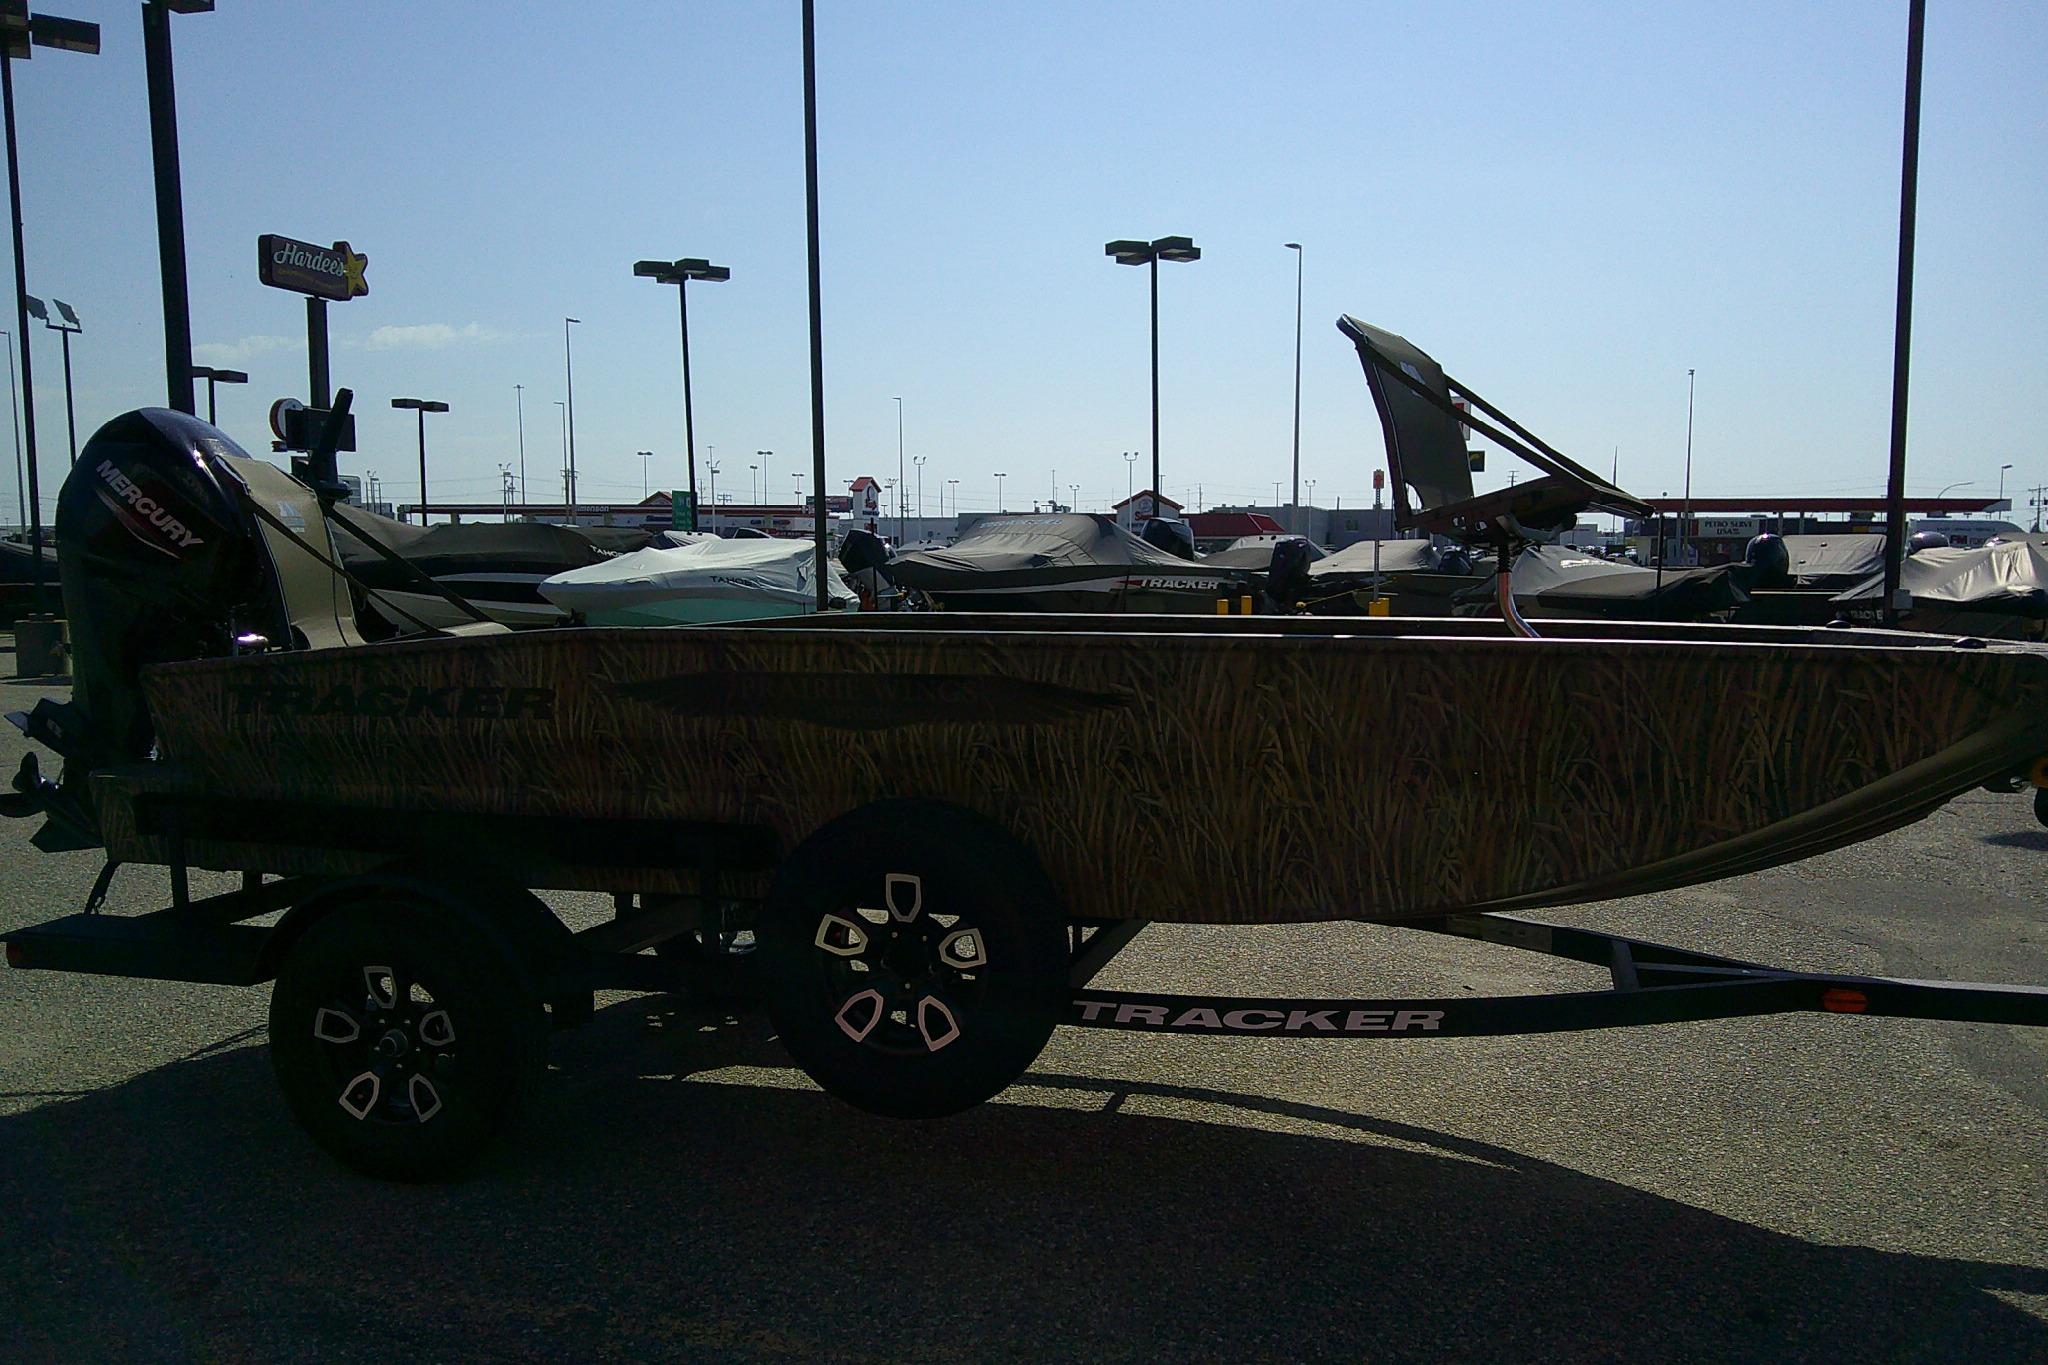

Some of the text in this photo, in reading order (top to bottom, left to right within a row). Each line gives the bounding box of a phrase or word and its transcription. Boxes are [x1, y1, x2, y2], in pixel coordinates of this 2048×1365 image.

[273, 243, 344, 277] Hardee's
[96, 459, 205, 548] MERCURY
[1140, 578, 1220, 590] TRACKER
[227, 684, 556, 719] TRACKER
[739, 676, 979, 705] PRAIRIE WINGS
[1072, 1000, 1446, 1032] TRACKER
